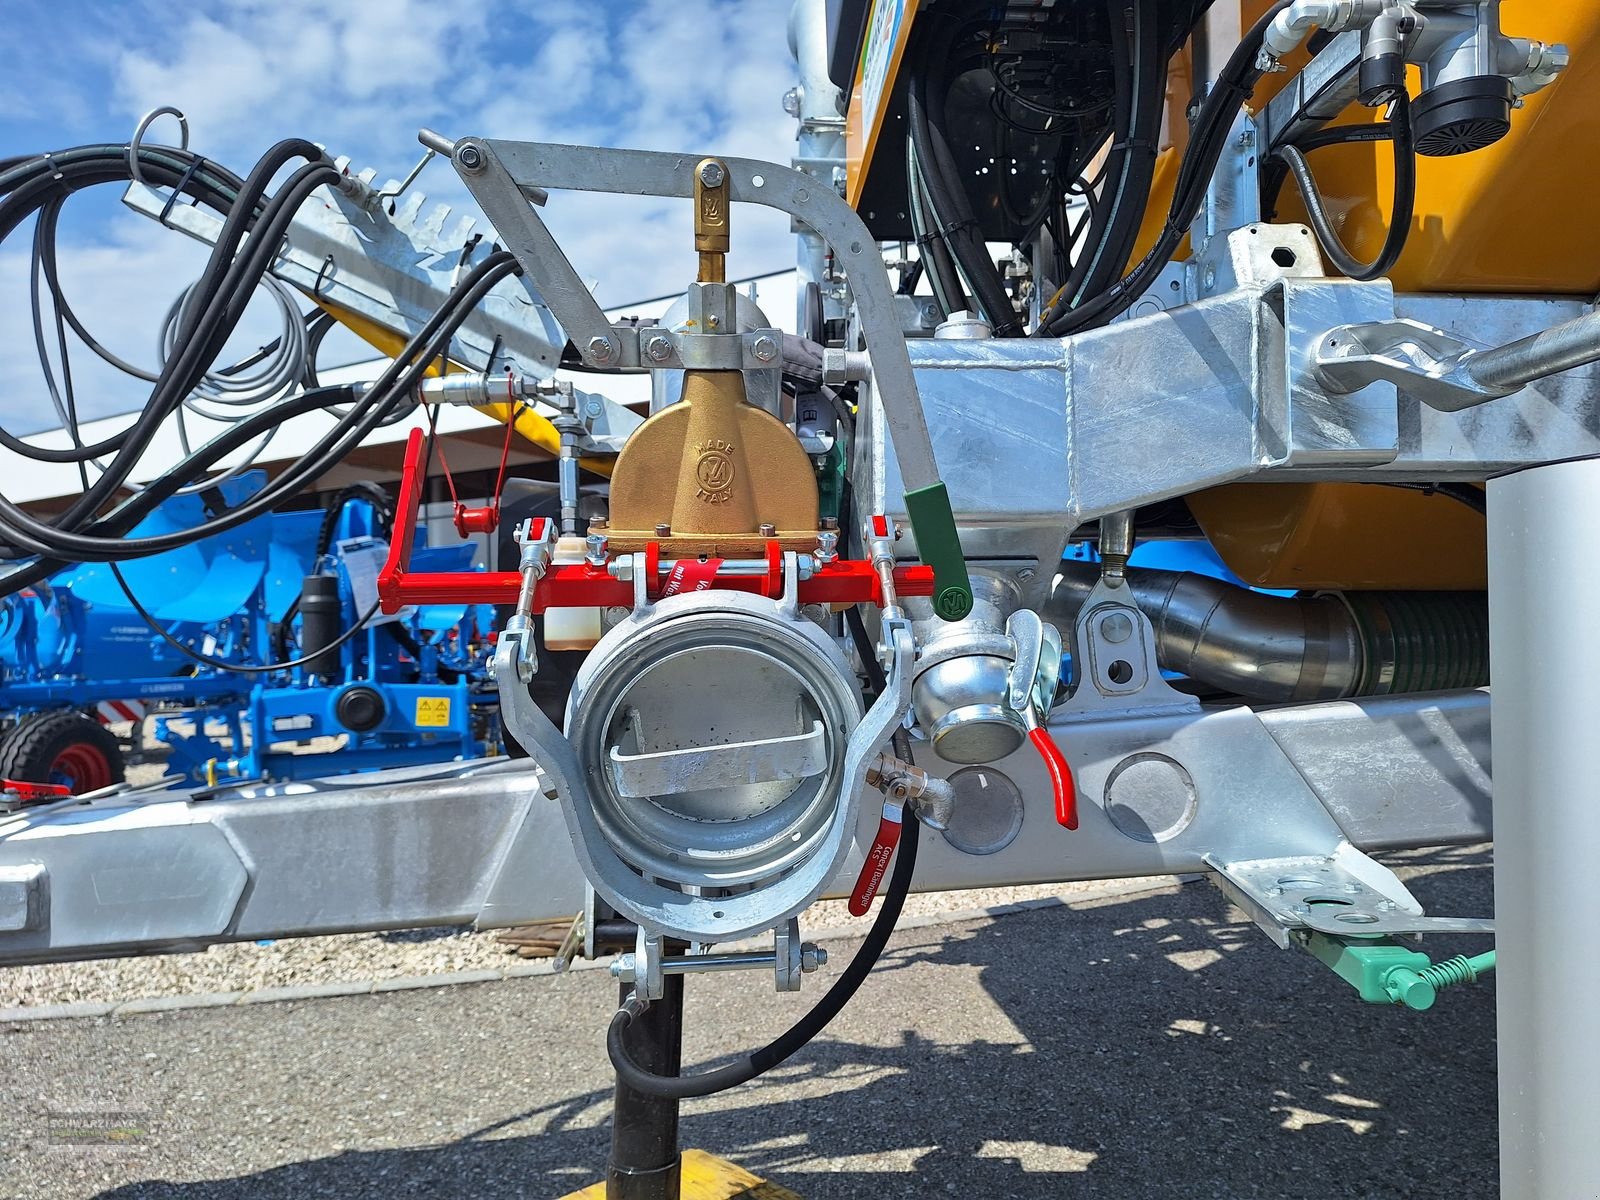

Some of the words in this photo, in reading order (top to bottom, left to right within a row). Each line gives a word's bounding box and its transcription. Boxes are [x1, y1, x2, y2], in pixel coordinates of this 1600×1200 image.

[694, 440, 735, 456] MADE
[696, 488, 733, 504] ITALY
[673, 565, 685, 580] mit
[664, 580, 681, 598] Was
[872, 843, 884, 861] ACS
[879, 846, 892, 868] Conex
